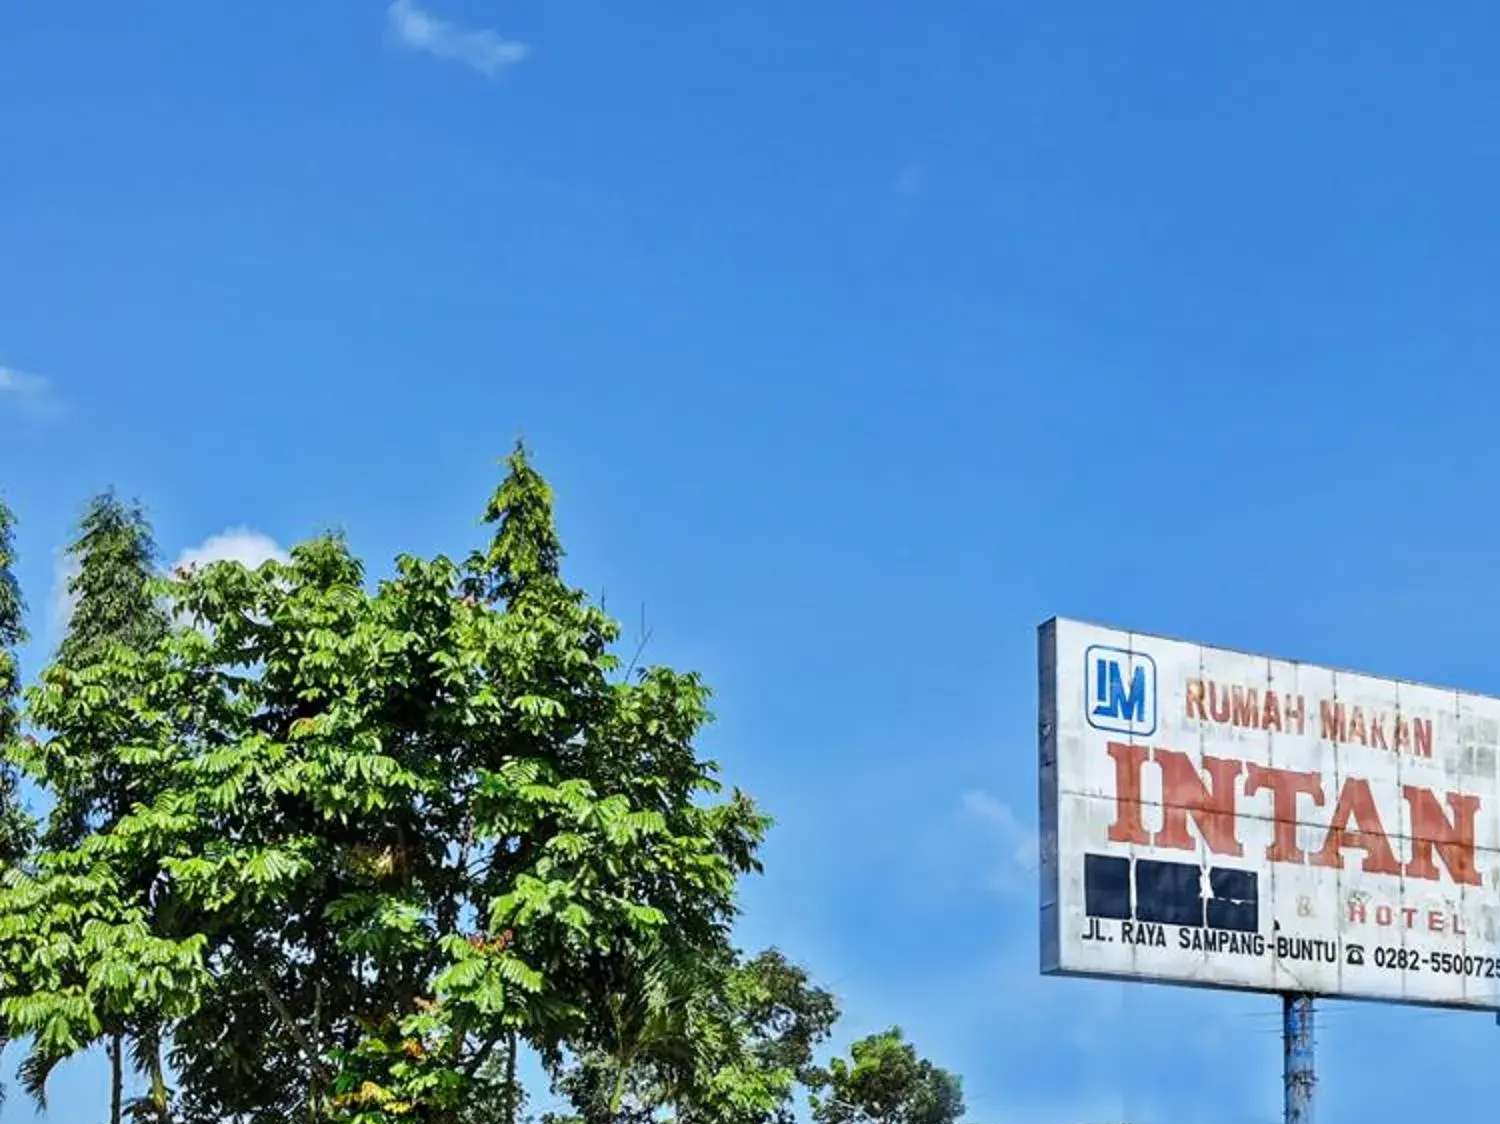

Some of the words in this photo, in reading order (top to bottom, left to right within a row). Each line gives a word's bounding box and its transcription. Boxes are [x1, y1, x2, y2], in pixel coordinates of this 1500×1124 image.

[1186, 677, 1305, 735] RUMAH
[1320, 700, 1433, 758] MAKAN
[1107, 741, 1483, 886] INTAN
[1082, 917, 1113, 943] JL.
[1121, 921, 1167, 948] RAYA
[1179, 926, 1336, 963] SAMPANG-BUNTU
[1349, 902, 1467, 935] HOTEL
